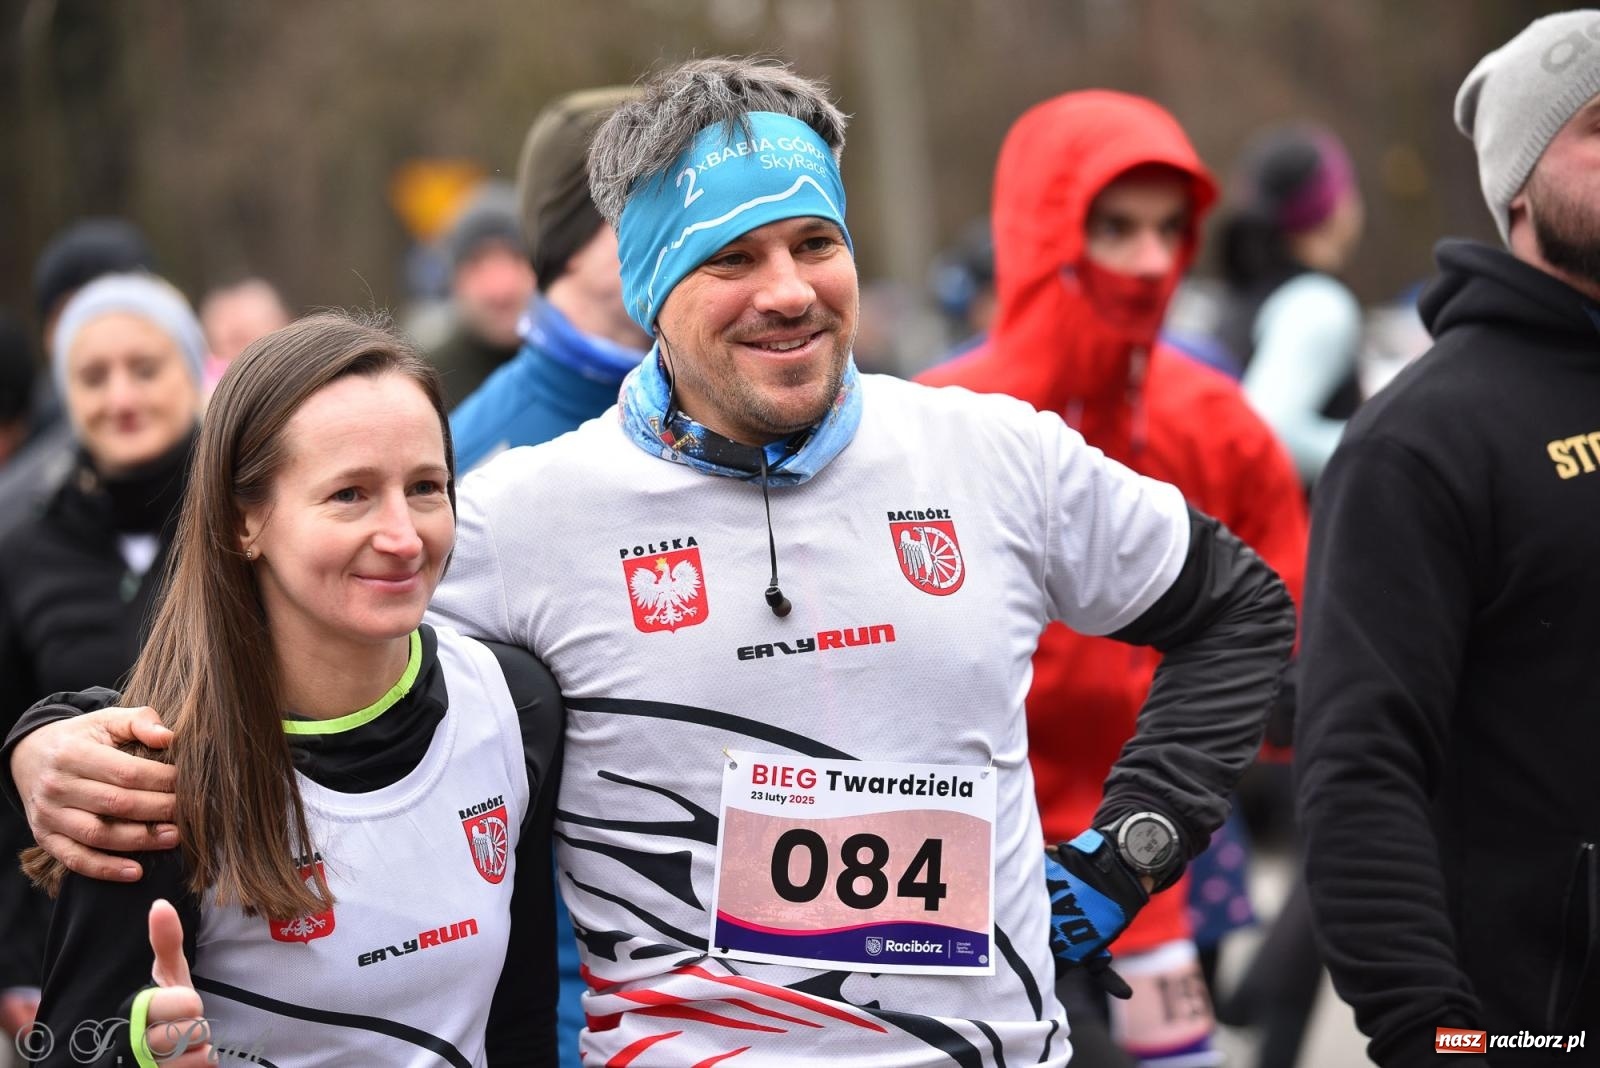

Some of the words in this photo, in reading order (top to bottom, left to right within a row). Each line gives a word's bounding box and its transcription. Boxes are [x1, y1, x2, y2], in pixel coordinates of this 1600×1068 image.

[777, 136, 827, 164] GÓRA
[760, 153, 827, 178] SkyRace
[887, 508, 952, 522] RACIBÓRZ
[619, 535, 699, 560] POLSKA
[751, 763, 817, 790] BIEG
[826, 770, 974, 798] Twardziela
[458, 795, 505, 820] RACIBÓRZ
[750, 790, 764, 800] 23
[765, 792, 788, 805] luty
[789, 794, 816, 805] 2025
[771, 828, 947, 912] 084
[885, 938, 943, 954] Racibórz
